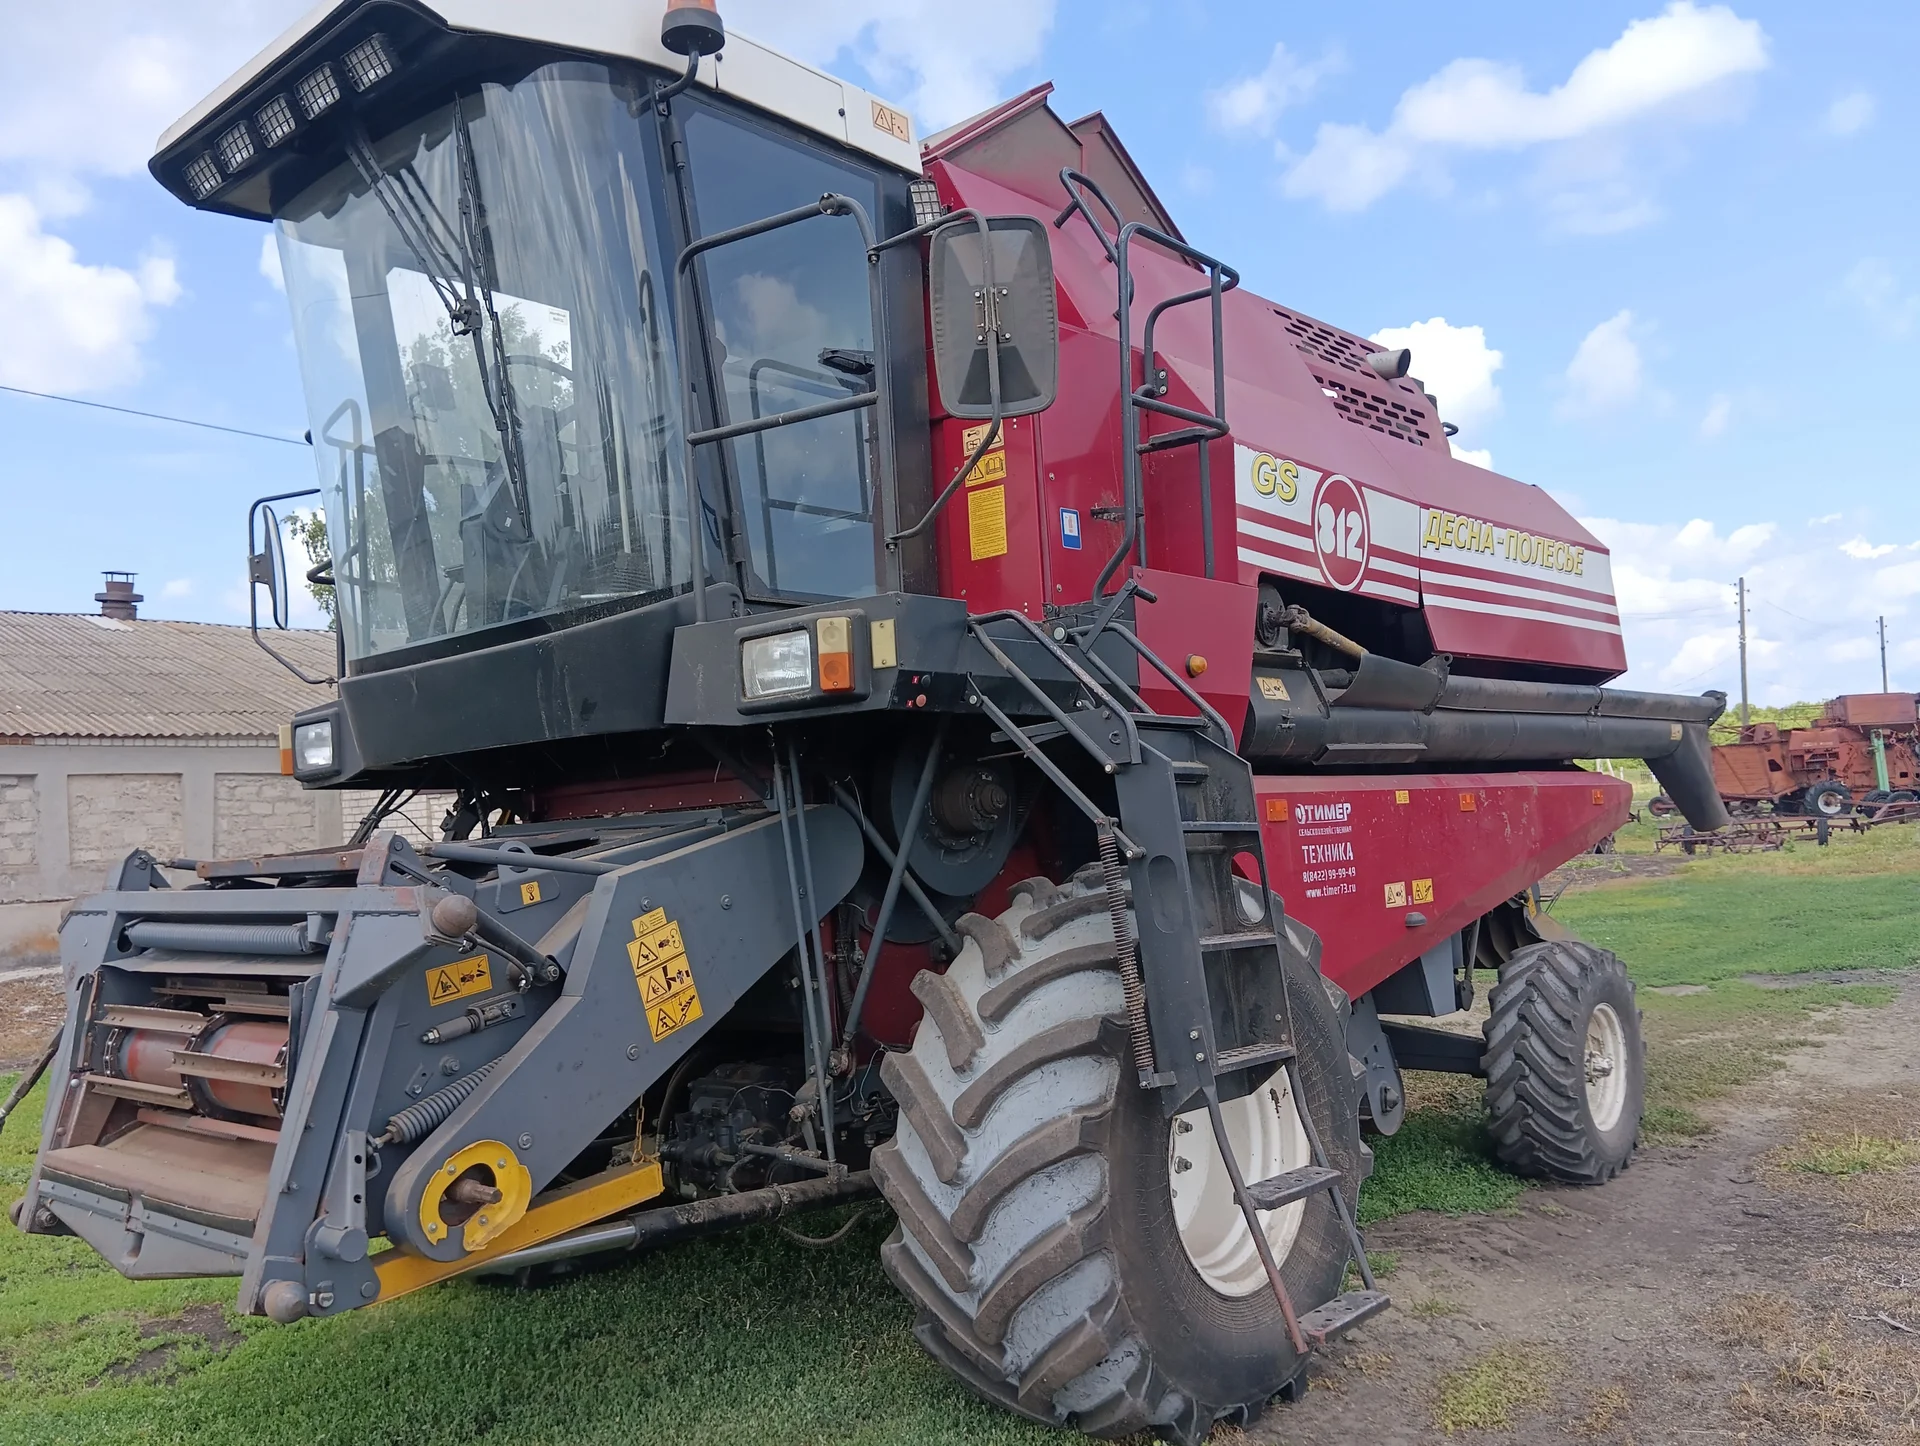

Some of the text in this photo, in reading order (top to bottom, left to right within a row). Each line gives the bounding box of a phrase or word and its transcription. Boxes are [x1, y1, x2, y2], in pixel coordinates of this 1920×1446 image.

[1251, 453, 1299, 503] GS
[1318, 502, 1363, 563] 812
[1423, 509, 1584, 576] ДЕСНА-ПОЛЕСЬЕ
[1302, 842, 1353, 864] ТЕХНИКА
[1305, 883, 1357, 899] www.timer73.ru
